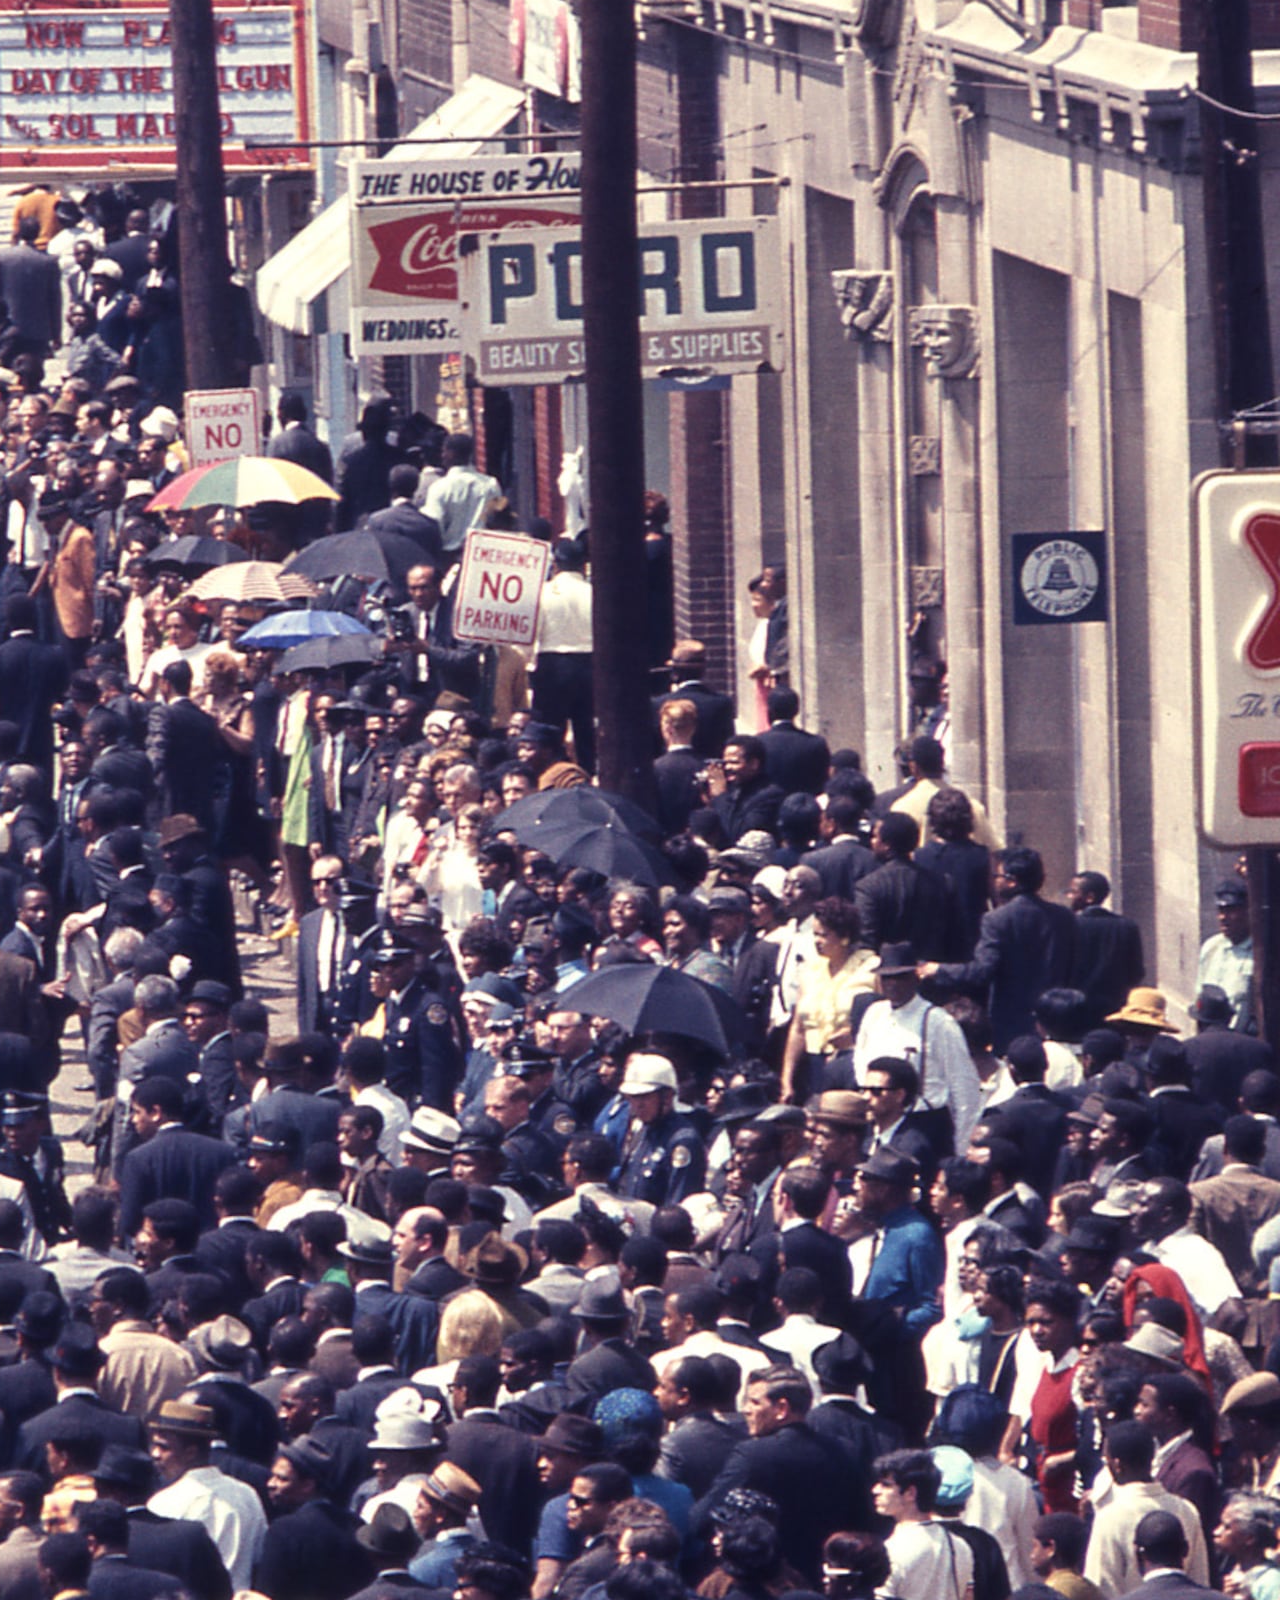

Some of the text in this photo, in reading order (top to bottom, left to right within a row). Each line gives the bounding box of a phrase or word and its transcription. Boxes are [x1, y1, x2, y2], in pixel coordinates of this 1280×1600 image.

[26, 18, 237, 49] NOW PLAG
[11, 67, 61, 95] DAY
[69, 68, 101, 93] OF
[111, 66, 165, 93] THE
[48, 113, 102, 140] SOL
[361, 173, 401, 198] THE
[409, 169, 485, 196] HOUSE
[493, 167, 521, 191] OF
[362, 318, 448, 343] WEDDINGS
[489, 344, 560, 369] BEAUTY
[648, 343, 664, 361] &
[670, 332, 763, 359] SUPPLIES
[205, 423, 242, 450] NO
[473, 546, 541, 570] EMERGENCY
[480, 570, 523, 604] NO
[463, 606, 530, 635] PARKING
